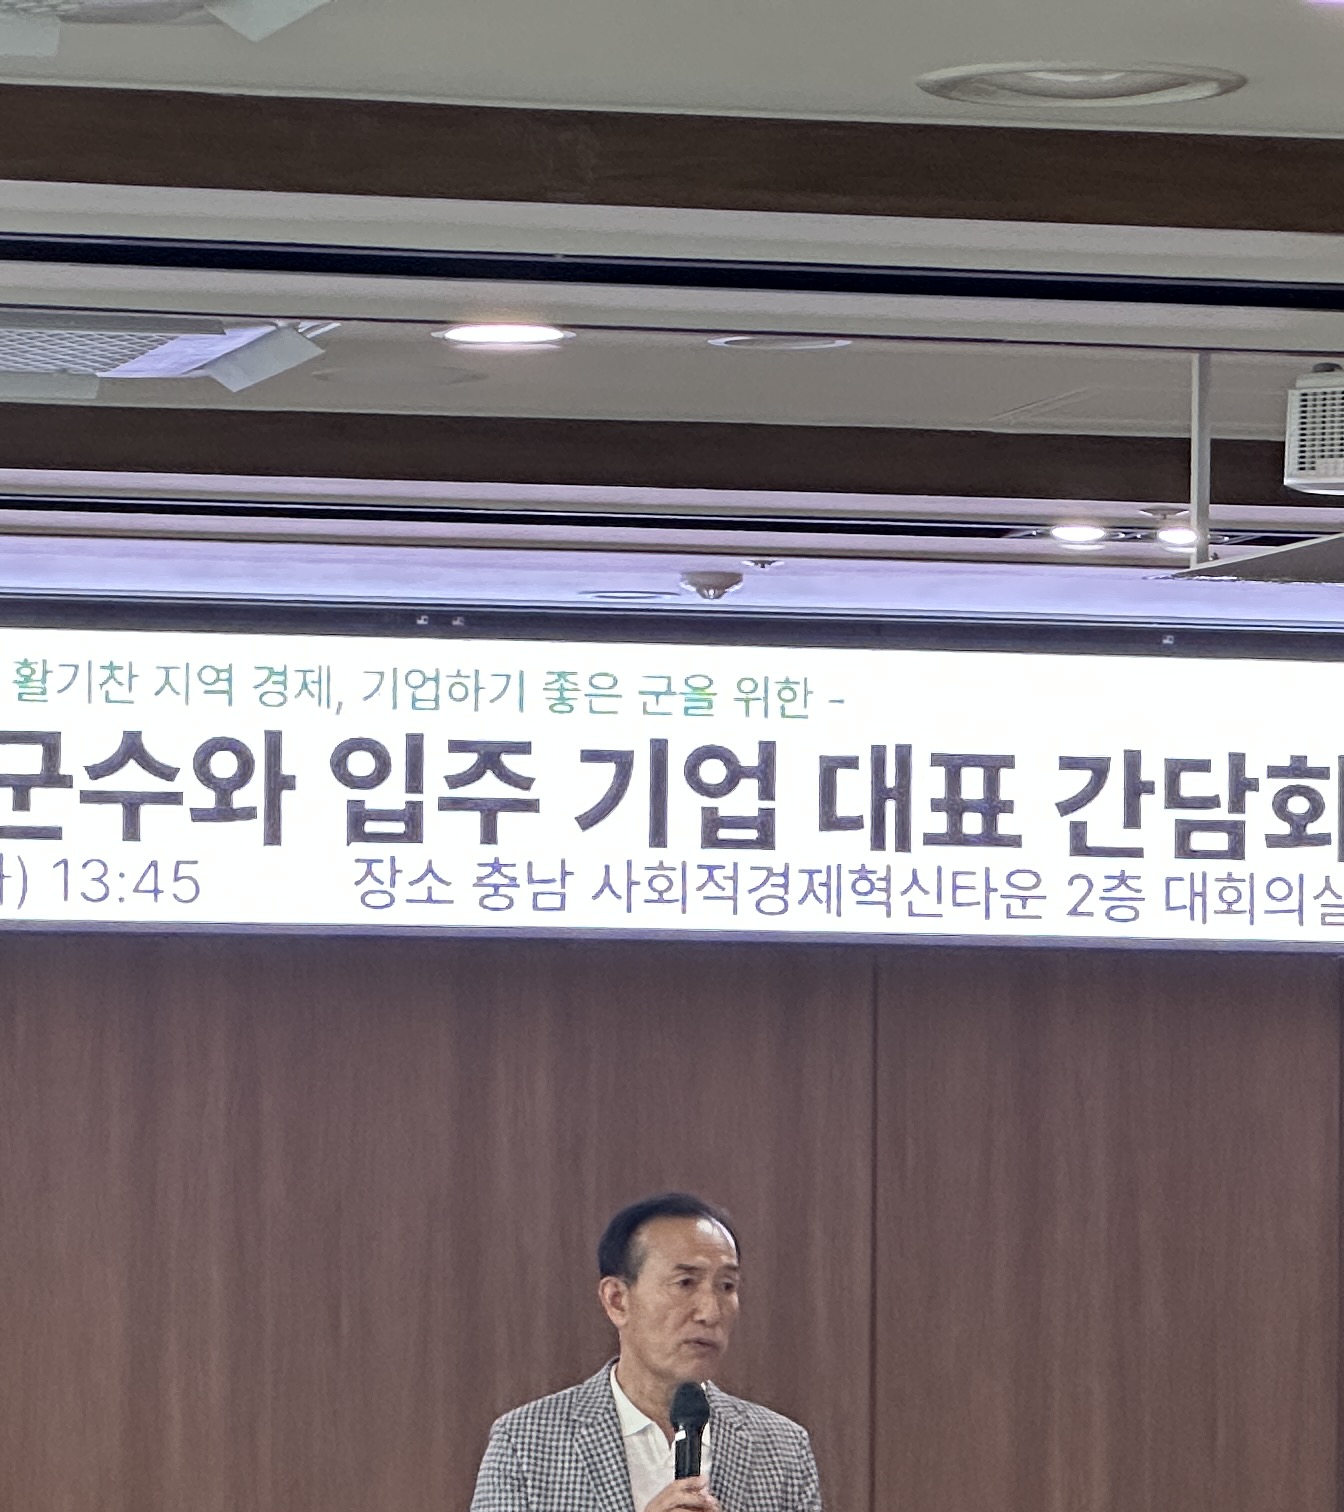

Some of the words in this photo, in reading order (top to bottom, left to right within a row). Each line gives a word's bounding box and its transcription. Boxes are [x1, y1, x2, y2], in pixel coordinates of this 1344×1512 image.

[12, 657, 139, 705] 활기찬
[153, 662, 233, 707] 지역
[252, 664, 343, 716] 경제,
[362, 667, 525, 713] 기업하기
[542, 670, 623, 716] 좋은
[637, 674, 718, 717] 군을
[733, 675, 814, 720] 위한
[329, 732, 541, 847] 입주
[573, 737, 777, 851] 기업
[818, 743, 1023, 854] 대표
[52, 858, 201, 904] 13:45
[353, 855, 455, 910] 장소
[472, 856, 575, 912] 충남
[591, 859, 1047, 921] 사회적경제혁신타운
[1065, 869, 1146, 923] 2층
